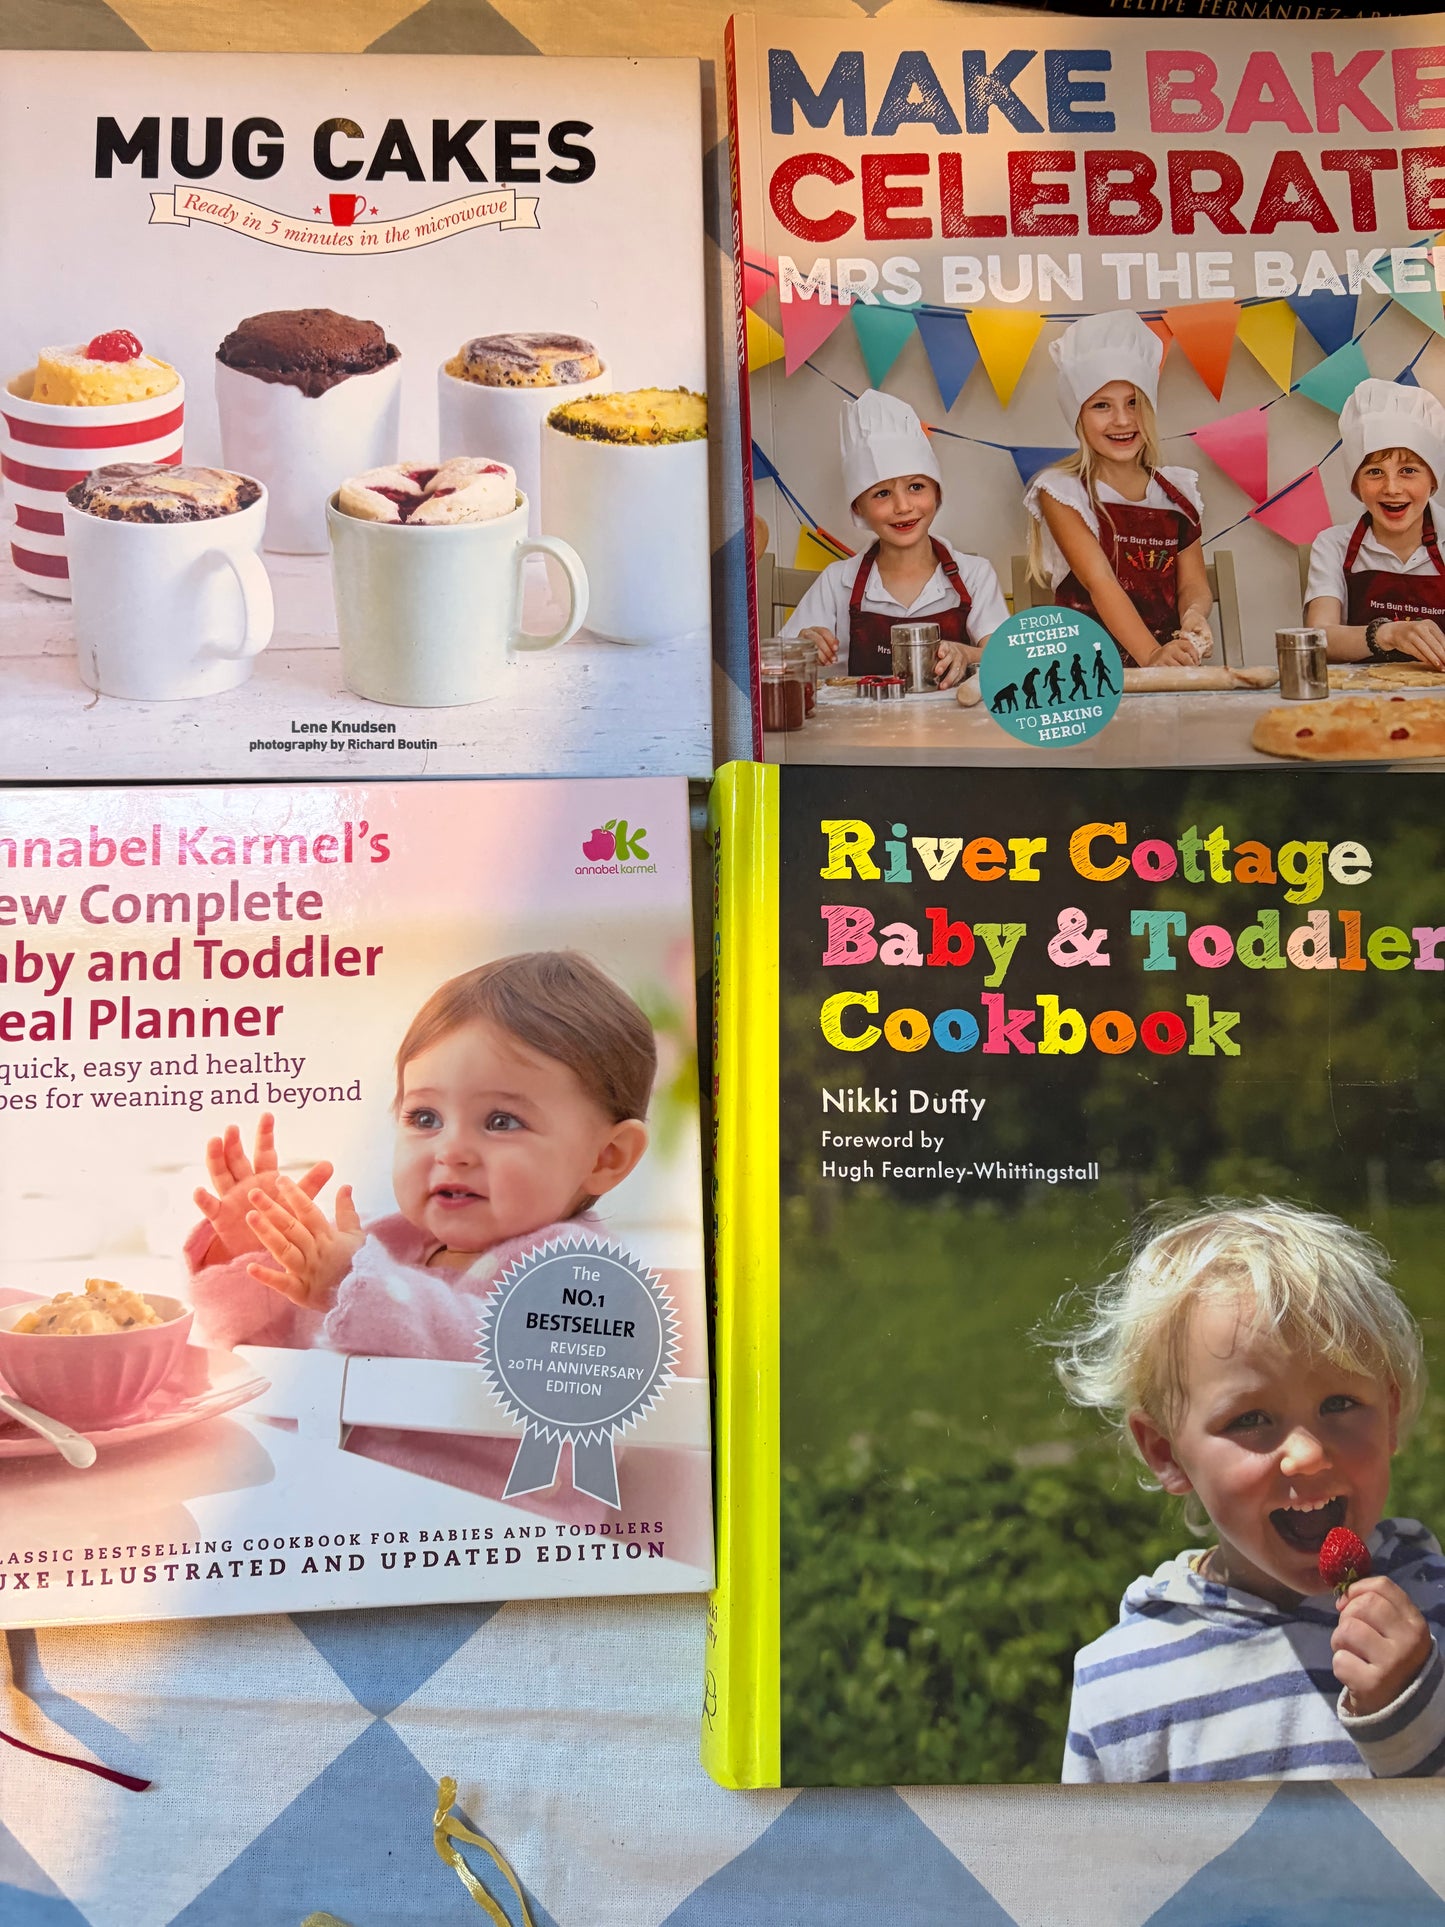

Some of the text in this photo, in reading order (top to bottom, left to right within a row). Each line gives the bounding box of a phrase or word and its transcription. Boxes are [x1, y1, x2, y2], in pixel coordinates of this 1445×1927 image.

[768, 46, 1445, 136] MAKE BAKE
[94, 116, 597, 184] MUG CAKES
[769, 147, 1445, 243] CELEBRATE
[183, 193, 508, 247] Ready in 5 minutes in the microwave
[777, 247, 1445, 305] MRS BUN THE BAKE
[1113, 534, 1128, 542] Mrs
[1130, 537, 1147, 545] Bun
[1149, 538, 1163, 546] the
[1370, 600, 1384, 609] Mrs
[1387, 602, 1402, 611] Bun
[1019, 613, 1063, 630] FROM
[1007, 625, 1080, 646] KITCHEN
[877, 645, 891, 654] Mrs
[1026, 642, 1067, 658] ZERO
[291, 719, 396, 734] Lene Knudsen
[1016, 706, 1103, 730] TO BAKING
[1038, 722, 1086, 741] HERO!
[249, 737, 437, 752] photography by Richard Boutin
[575, 863, 658, 874] annabel karmel
[819, 819, 1373, 905] River Cottage
[79, 881, 323, 935] Complete
[820, 904, 1445, 987] Baby & Toddler
[88, 937, 180, 982] and
[194, 934, 384, 980] Toddler
[0, 995, 283, 1042] eal Planner
[819, 990, 1242, 1057] Cookbook
[83, 1062, 142, 1082] easy
[150, 1055, 199, 1078] and
[207, 1051, 306, 1079] healthy
[45, 1086, 84, 1109] for
[90, 1085, 203, 1112] weaning
[210, 1083, 259, 1105] and
[267, 1081, 361, 1110] beyond
[821, 1088, 986, 1121] Nikki Duffy
[822, 1131, 945, 1153] Foreword by
[822, 1160, 1100, 1183] Hugh Fearnley-Whittingstall
[572, 1265, 600, 1282] The
[562, 1287, 605, 1308] NO.1
[525, 1312, 636, 1338] BESTSELLER
[549, 1341, 606, 1359] REVISED
[507, 1359, 644, 1381] 20TH ANNIVERSARY
[545, 1379, 602, 1395] EDITION
[0, 1520, 665, 1565] ASSIC BESTSELLING COOKBOOK FOR BABIES AND TODDLERS
[66, 1557, 288, 1587] ILLUSTRATED
[301, 1552, 366, 1574] AND
[381, 1546, 522, 1570] UPDATED
[537, 1541, 666, 1563] EDITION
